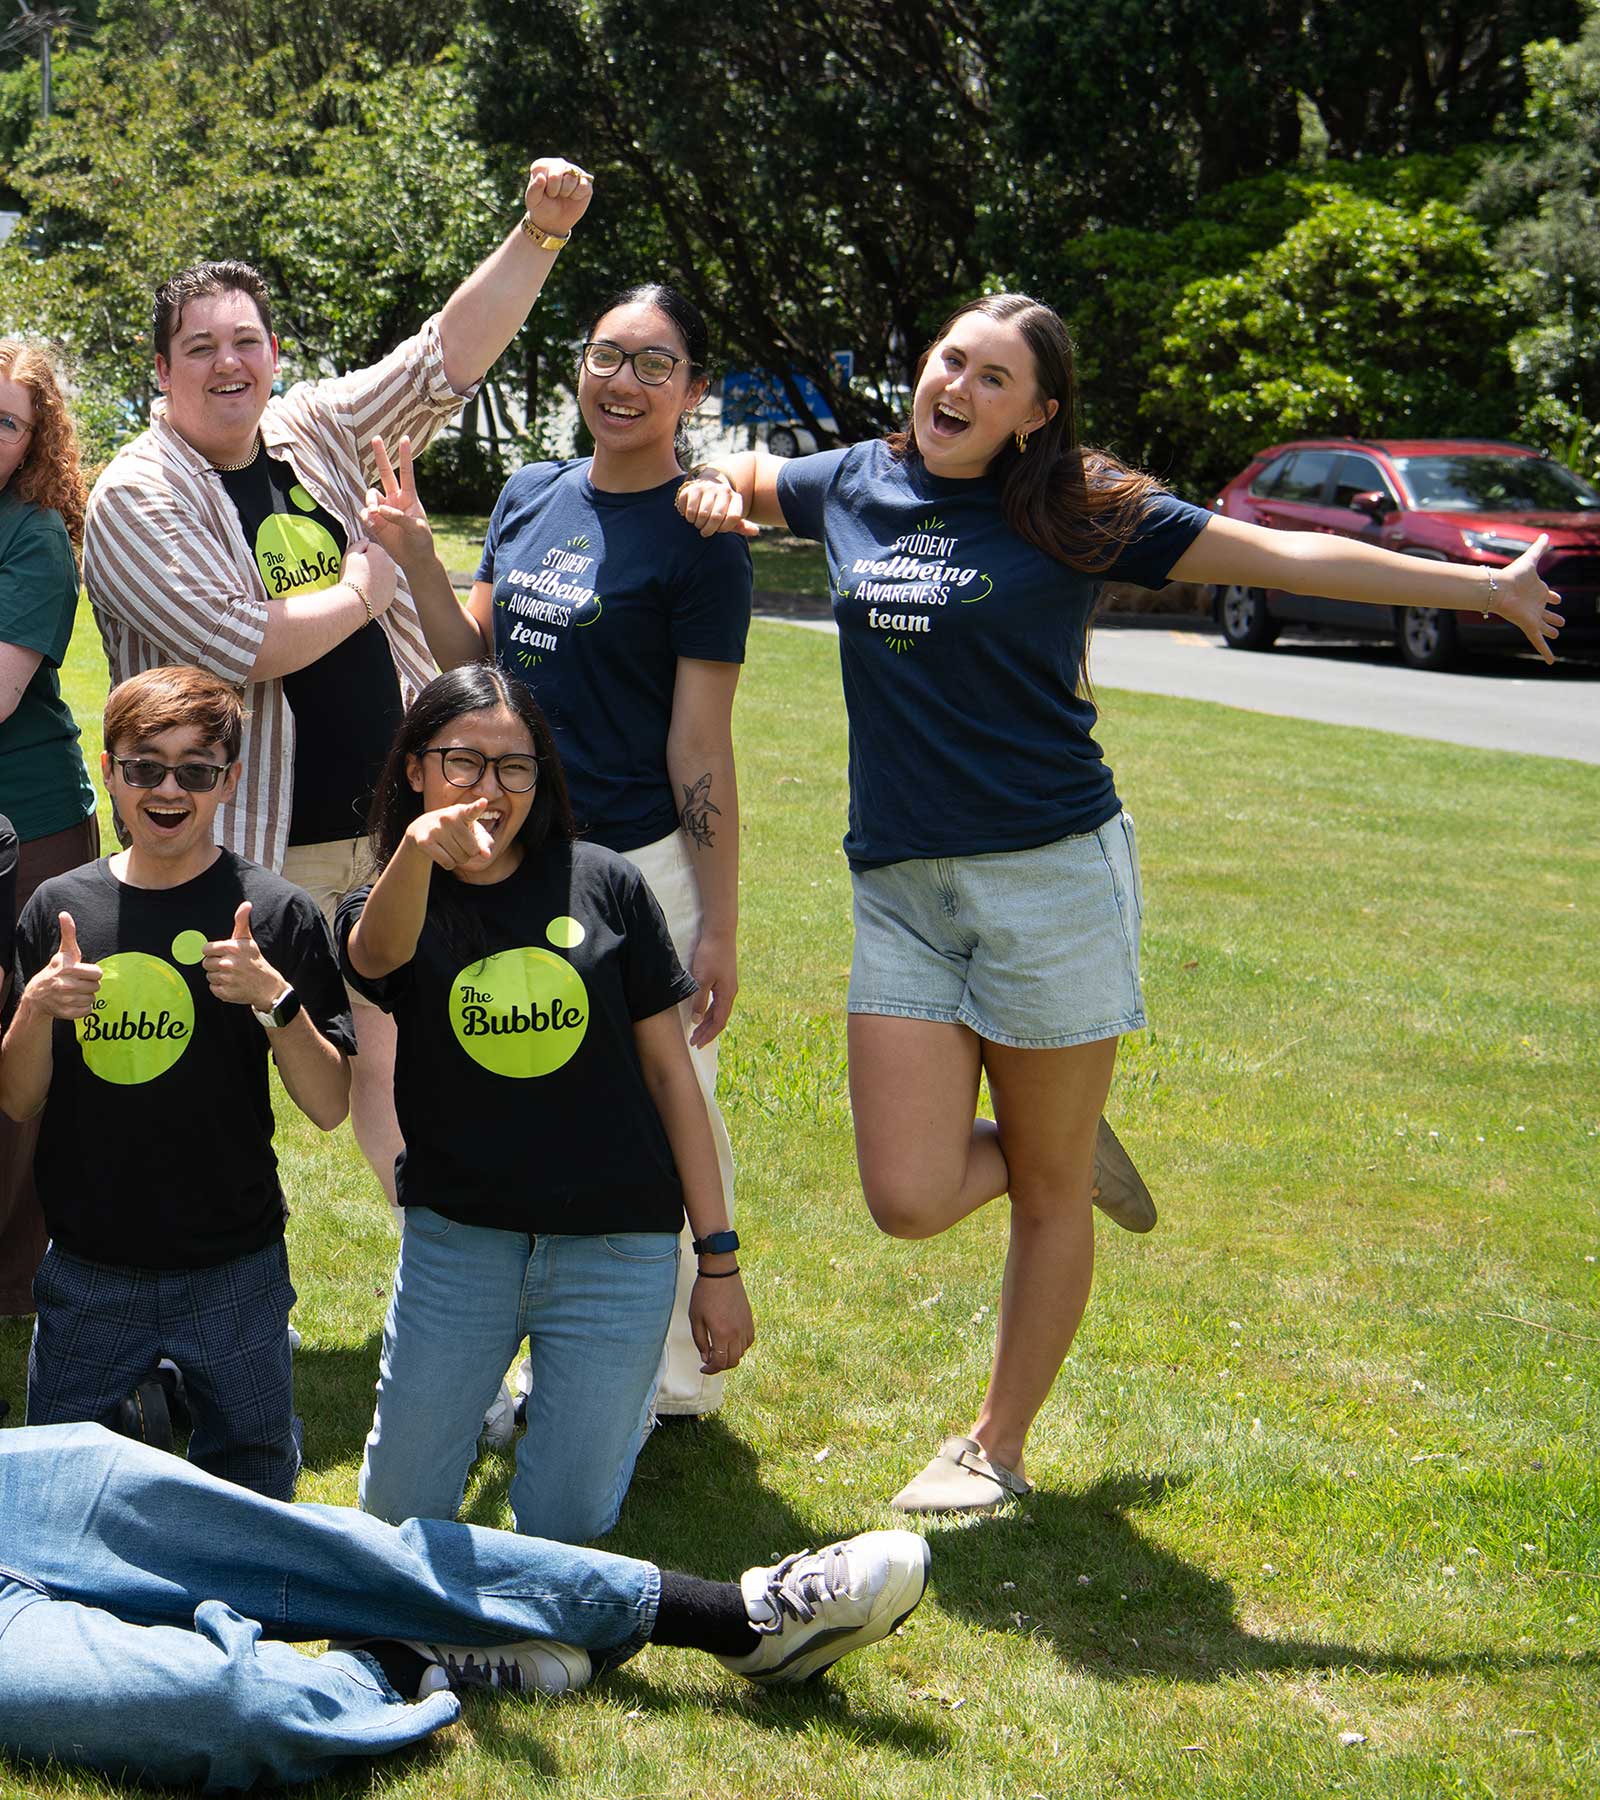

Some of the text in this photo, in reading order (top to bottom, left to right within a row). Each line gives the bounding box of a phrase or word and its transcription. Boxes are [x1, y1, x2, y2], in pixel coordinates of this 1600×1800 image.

[263, 551, 286, 567] The
[890, 533, 958, 557] STUDENT
[542, 547, 594, 574] STUDENT
[852, 556, 978, 586] wellbeing
[507, 569, 595, 609] wellbeing
[854, 581, 951, 606] AWARENESS
[507, 592, 572, 628] AWARENESS
[868, 607, 931, 633] team
[510, 621, 558, 652] team
[460, 986, 494, 1003] The
[83, 1011, 189, 1041] Bubble
[461, 998, 585, 1036] Bubble
